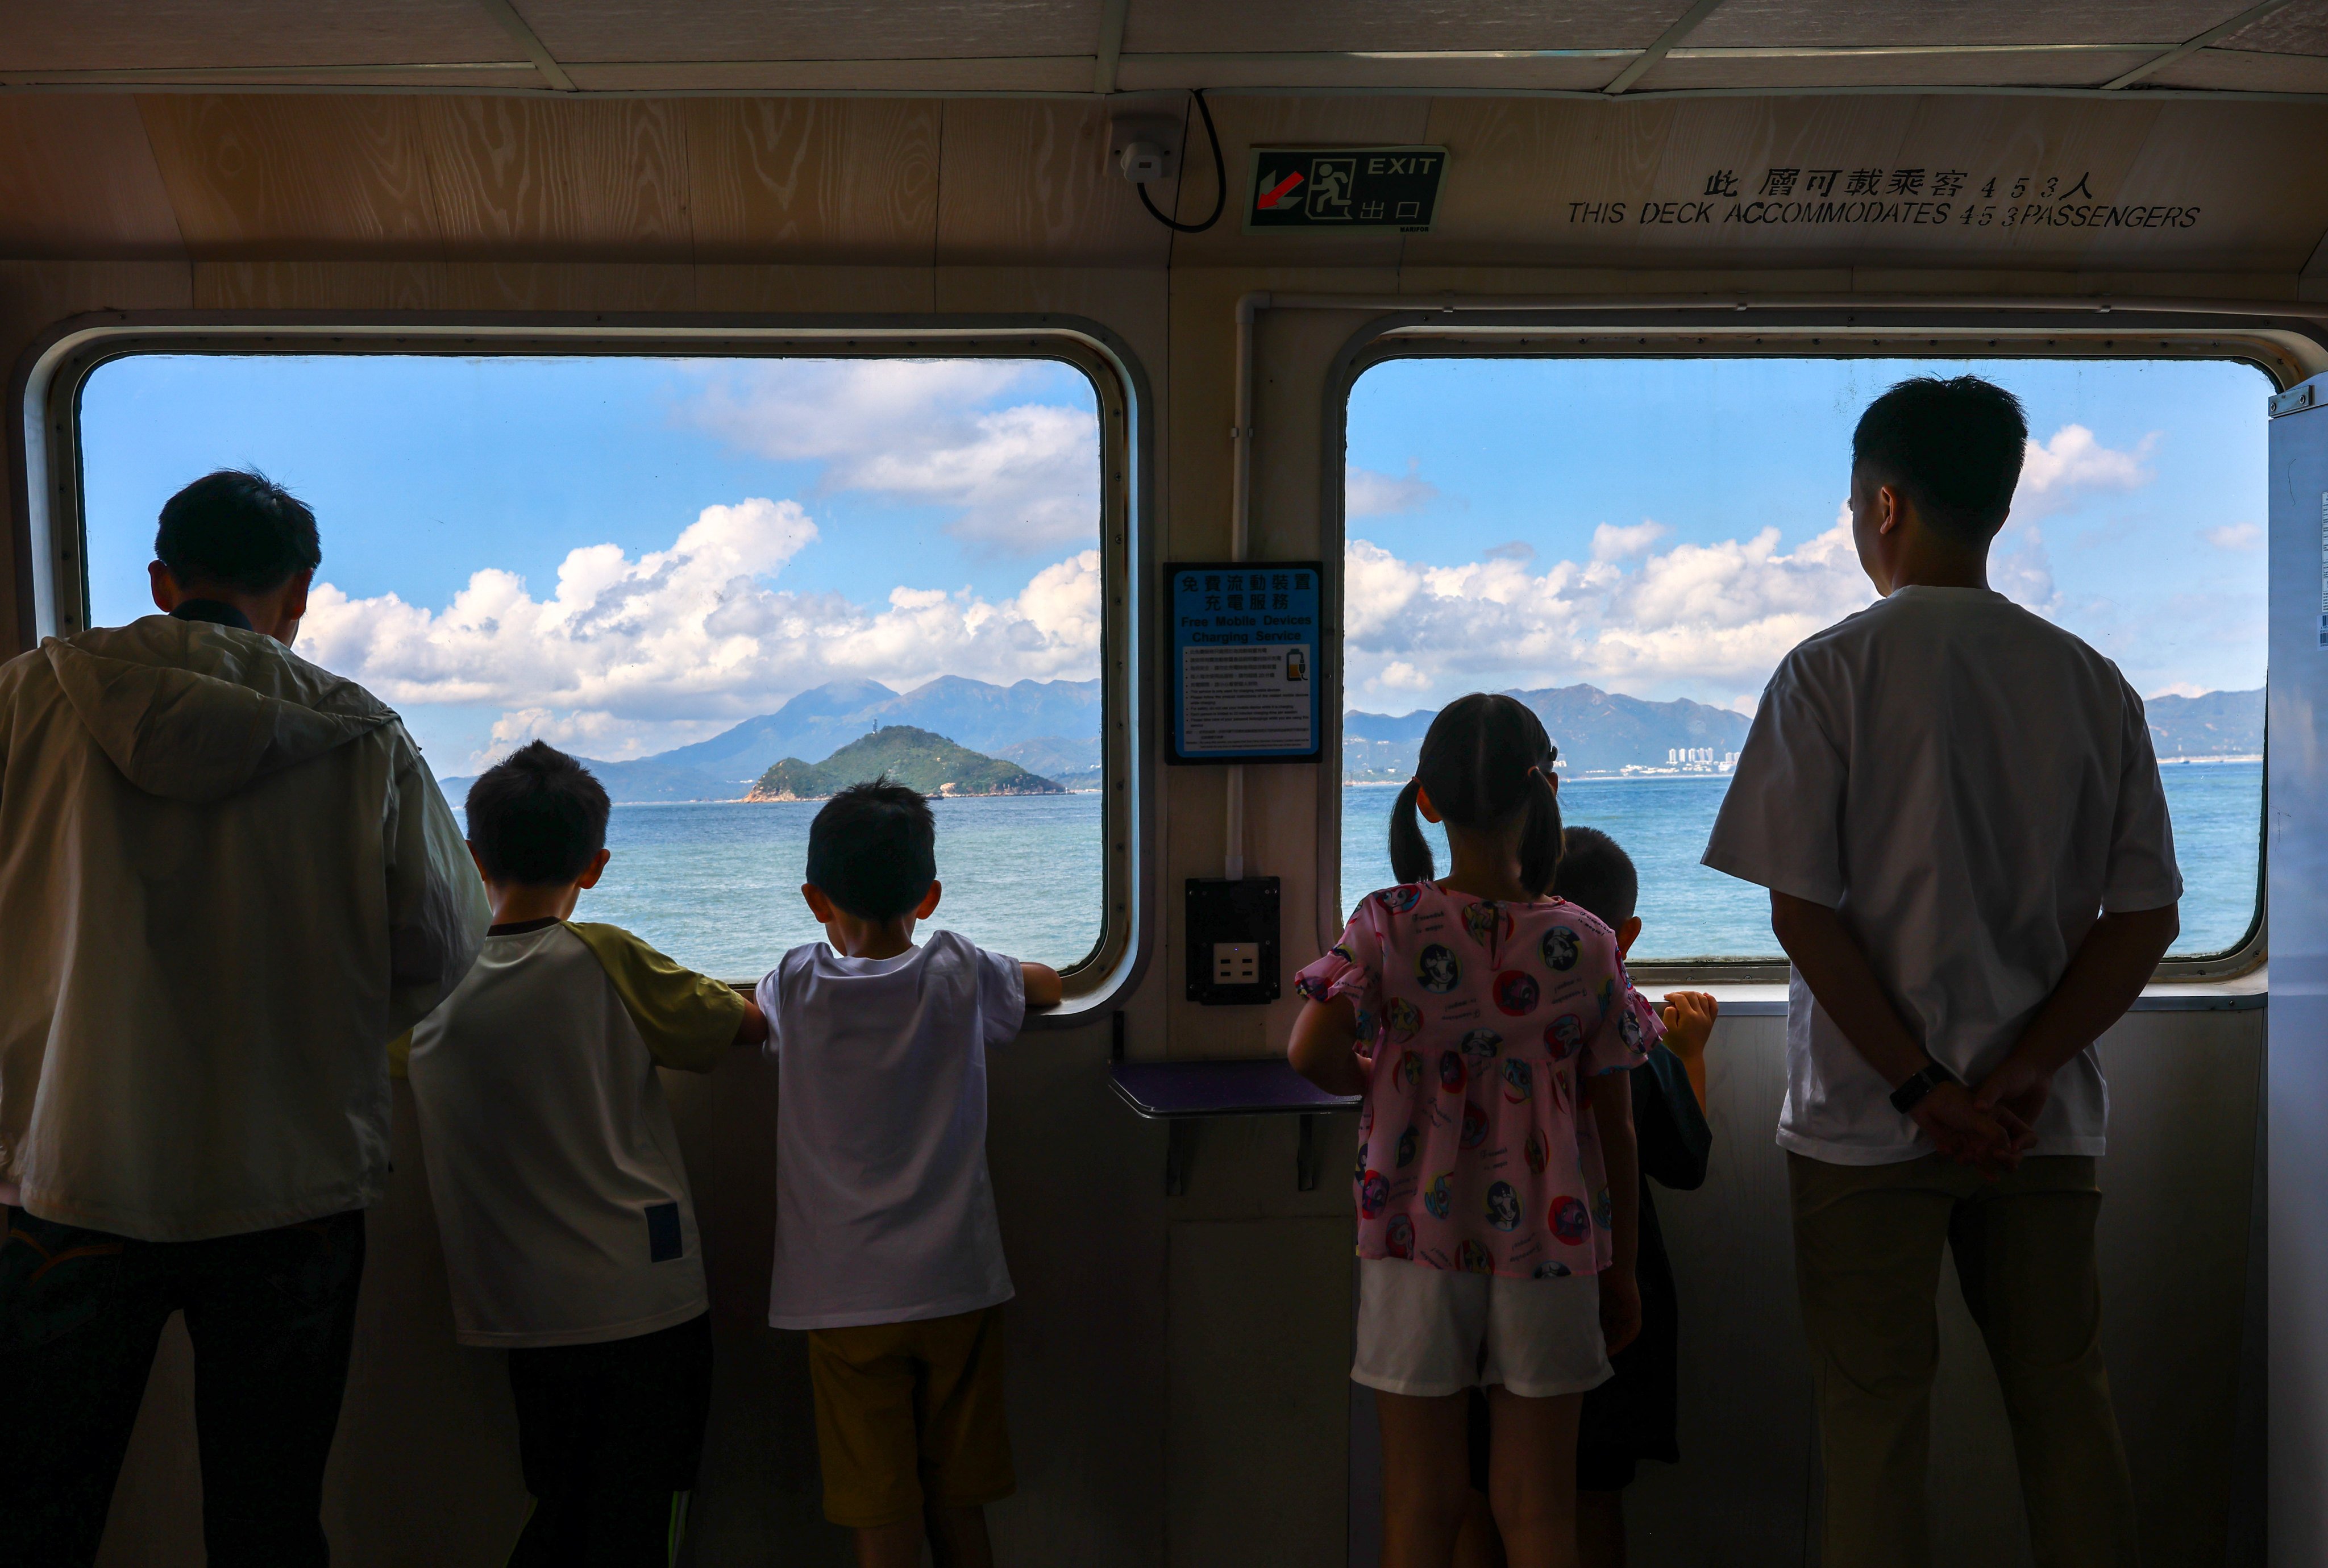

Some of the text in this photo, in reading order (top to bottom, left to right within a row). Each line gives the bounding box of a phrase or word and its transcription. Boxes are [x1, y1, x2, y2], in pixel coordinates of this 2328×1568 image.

[1367, 157, 1437, 174] EXIT
[1360, 199, 1420, 219] 出口
[1569, 202, 1627, 223] THIS
[1640, 202, 1715, 224] DECK
[1723, 202, 1951, 224] ACCOMMODATES
[1182, 573, 1311, 592] 免費流動裝置
[1204, 593, 1290, 612] 充電服務
[1181, 614, 1312, 627] Free Mobile Devices
[1192, 630, 1302, 643] Charging Service
